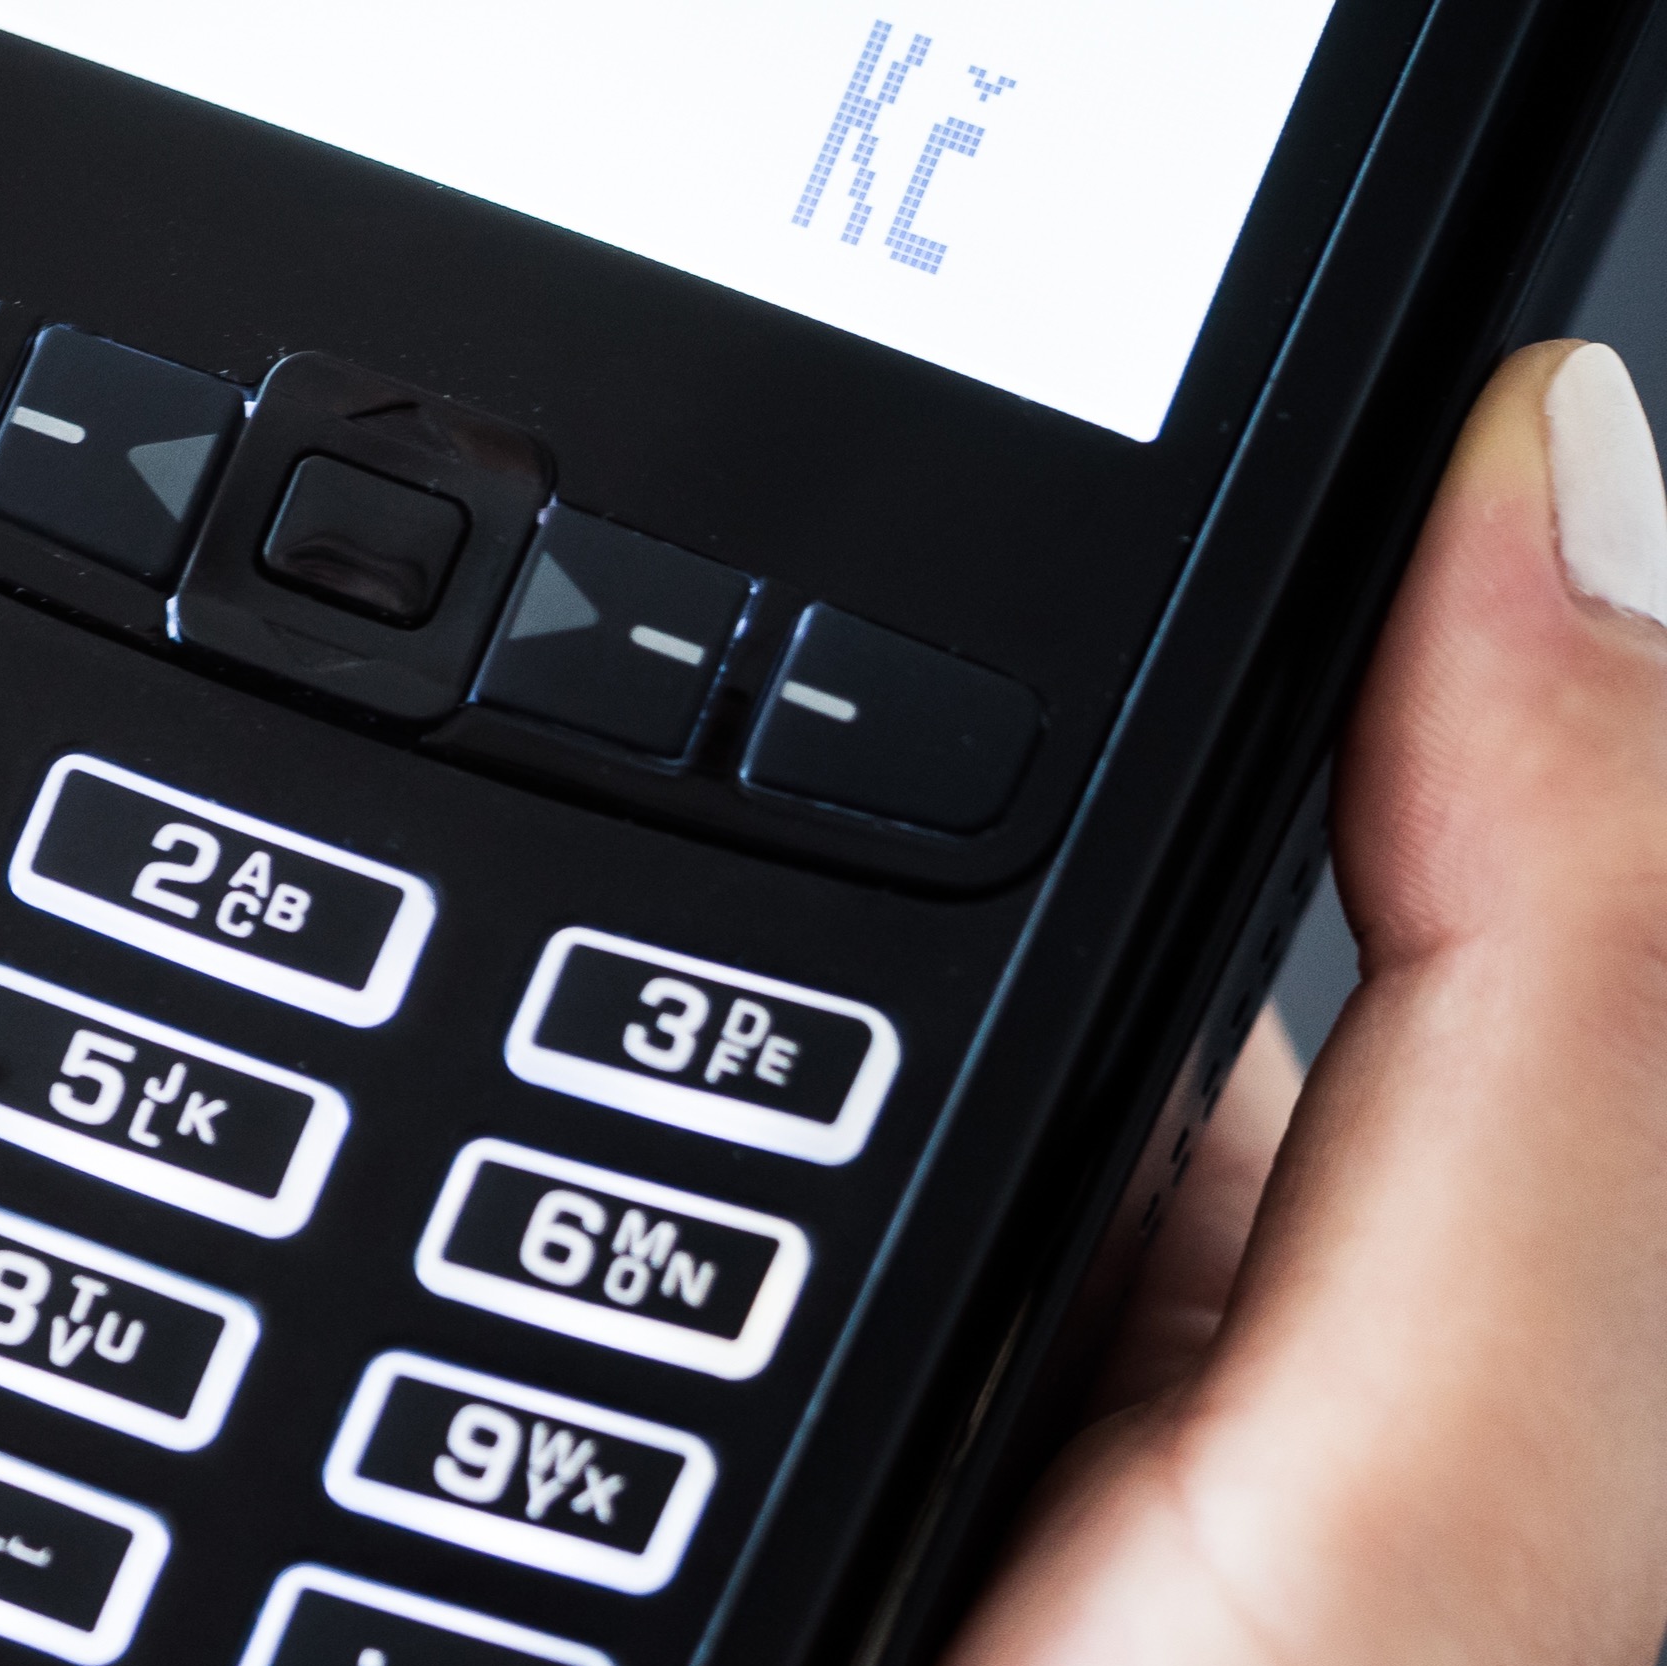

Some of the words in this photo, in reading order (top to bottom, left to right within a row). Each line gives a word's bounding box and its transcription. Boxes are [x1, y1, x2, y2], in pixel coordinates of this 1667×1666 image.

[791, 19, 1016, 275] Kč
[132, 823, 221, 918] 2
[623, 978, 709, 1072] 3
[49, 1029, 136, 1125] 5
[520, 1190, 606, 1286] 6
[434, 1404, 521, 1503] 9
